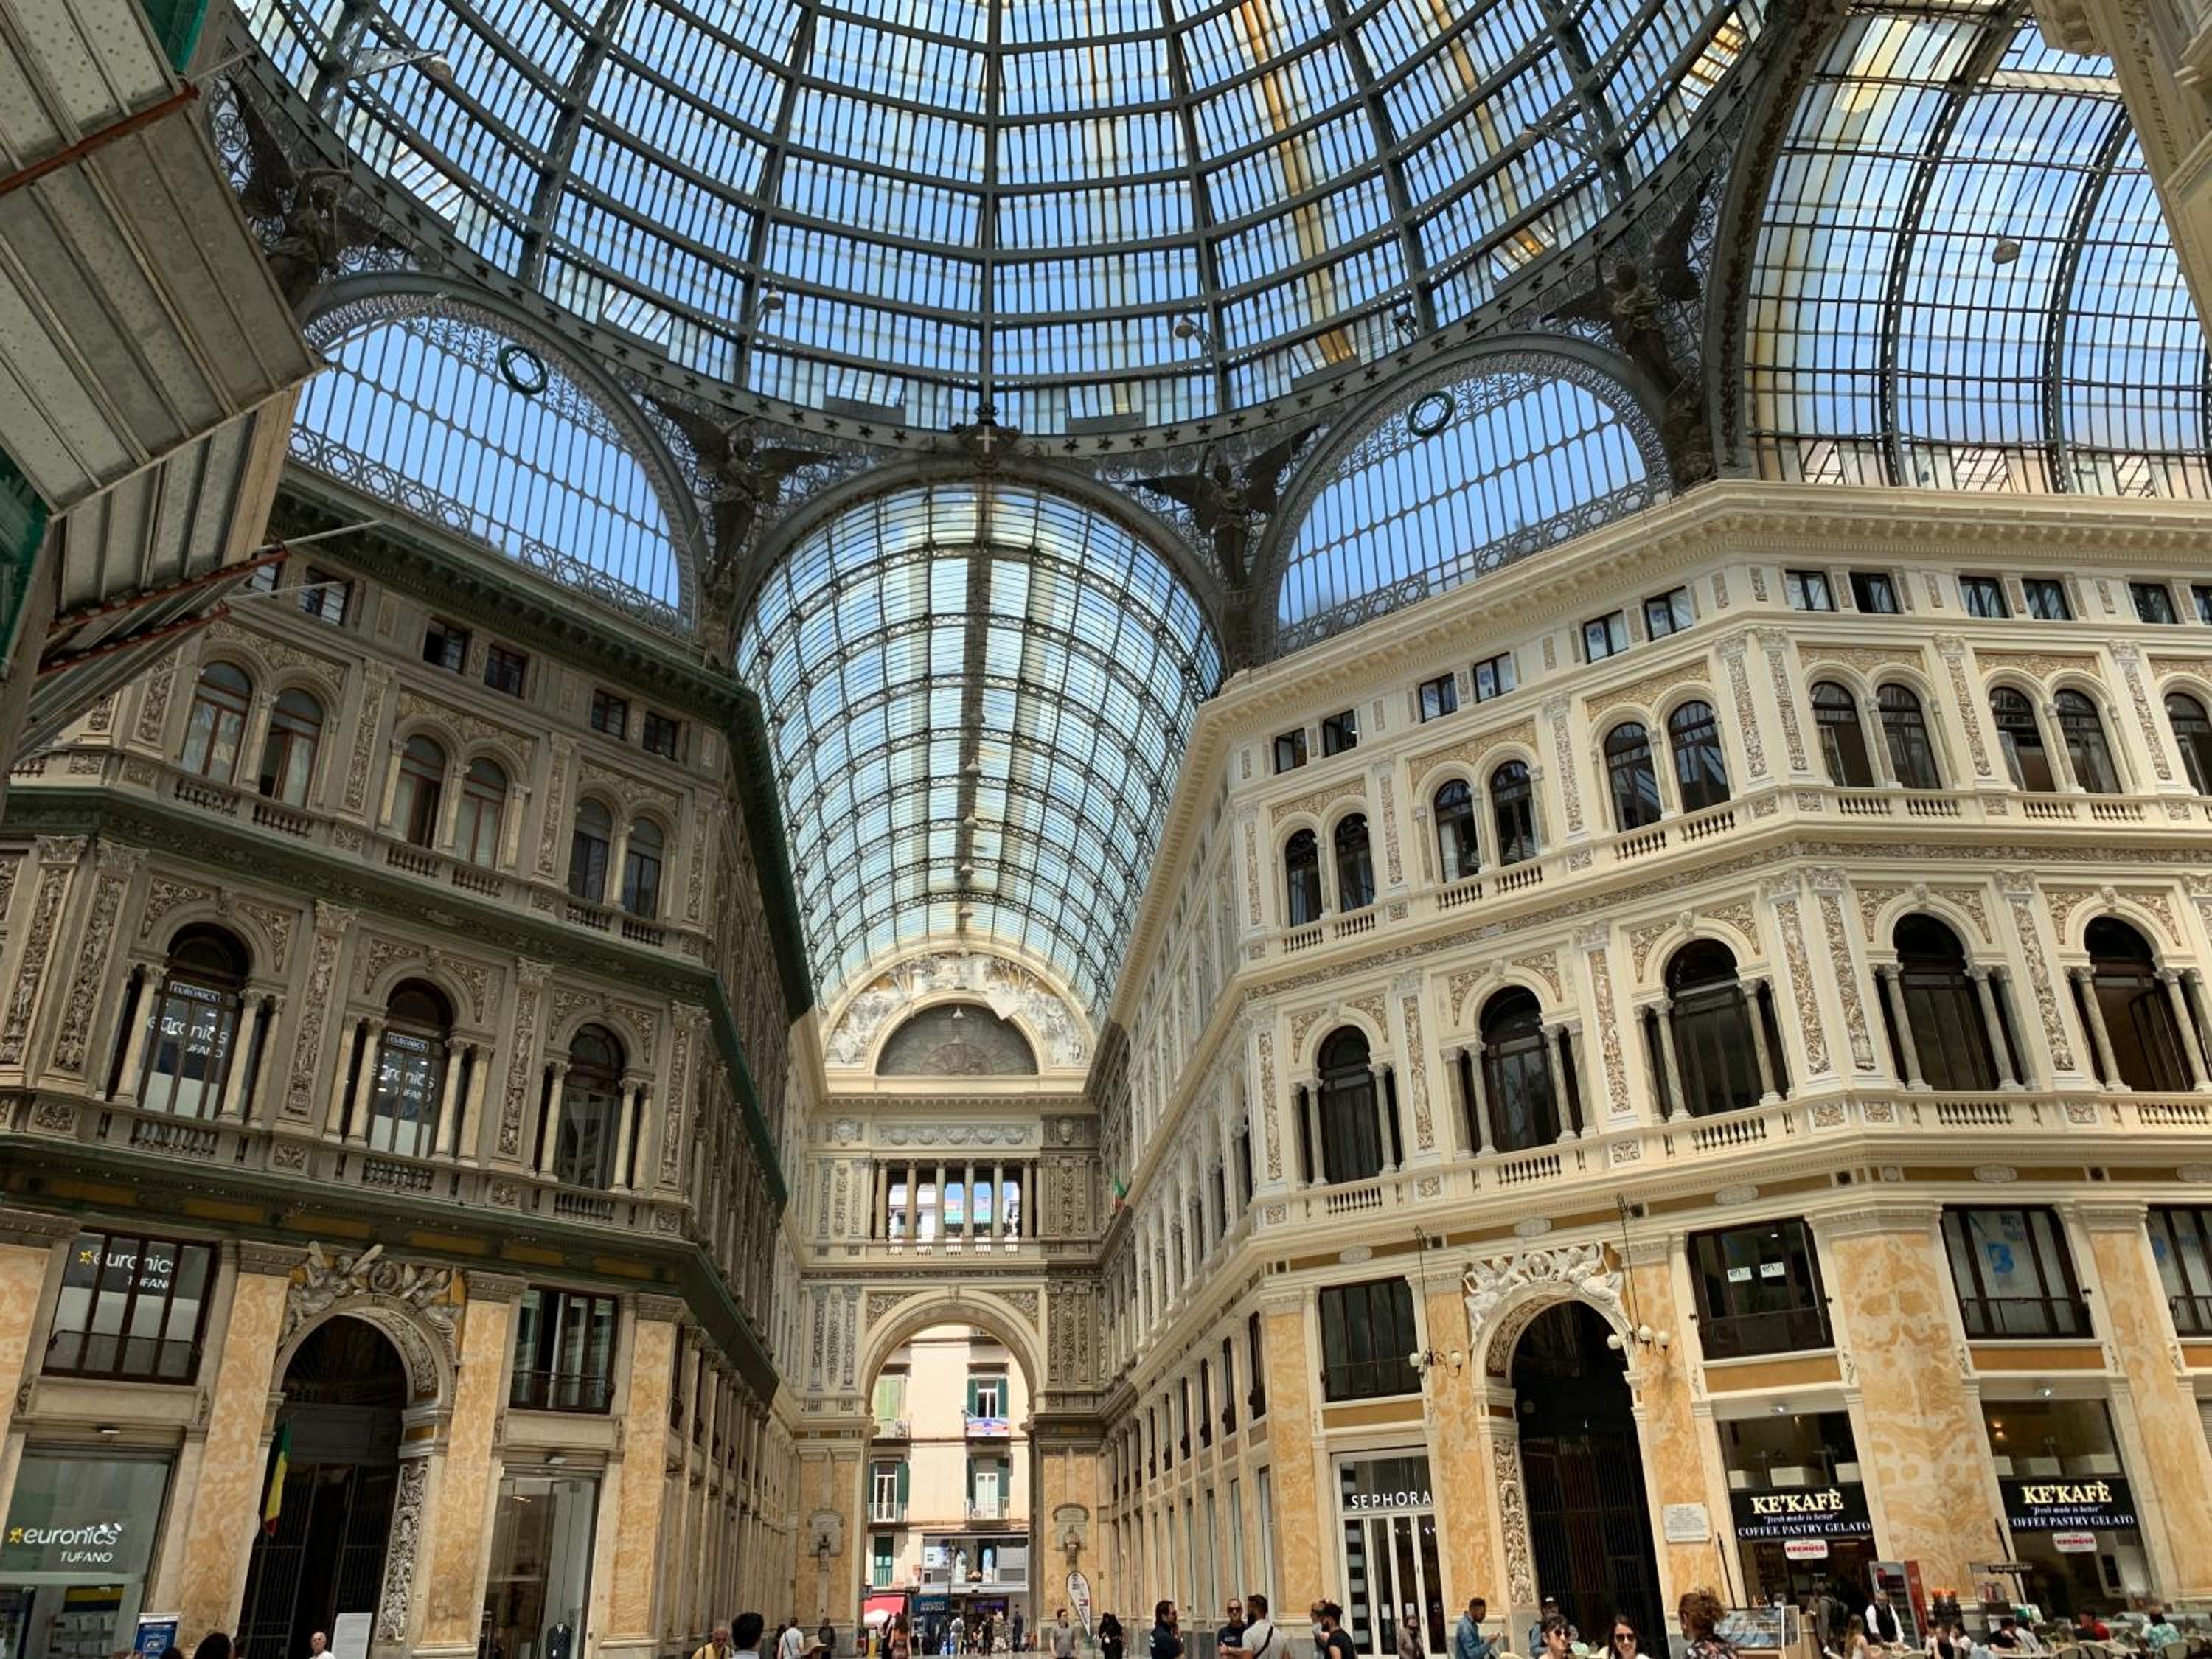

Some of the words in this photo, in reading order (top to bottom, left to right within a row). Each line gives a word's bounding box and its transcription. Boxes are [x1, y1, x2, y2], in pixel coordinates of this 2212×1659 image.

[1351, 1489, 1433, 1509] SEPHORA
[2049, 1516, 2088, 1526] PASTRY
[2091, 1514, 2135, 1525] GELATO
[23, 1527, 119, 1545] euronics
[1738, 1526, 1780, 1537] COFFEE
[1782, 1523, 1823, 1534] PASTRY
[1825, 1521, 1871, 1533] GELATO
[60, 1551, 114, 1563] TUFANO
